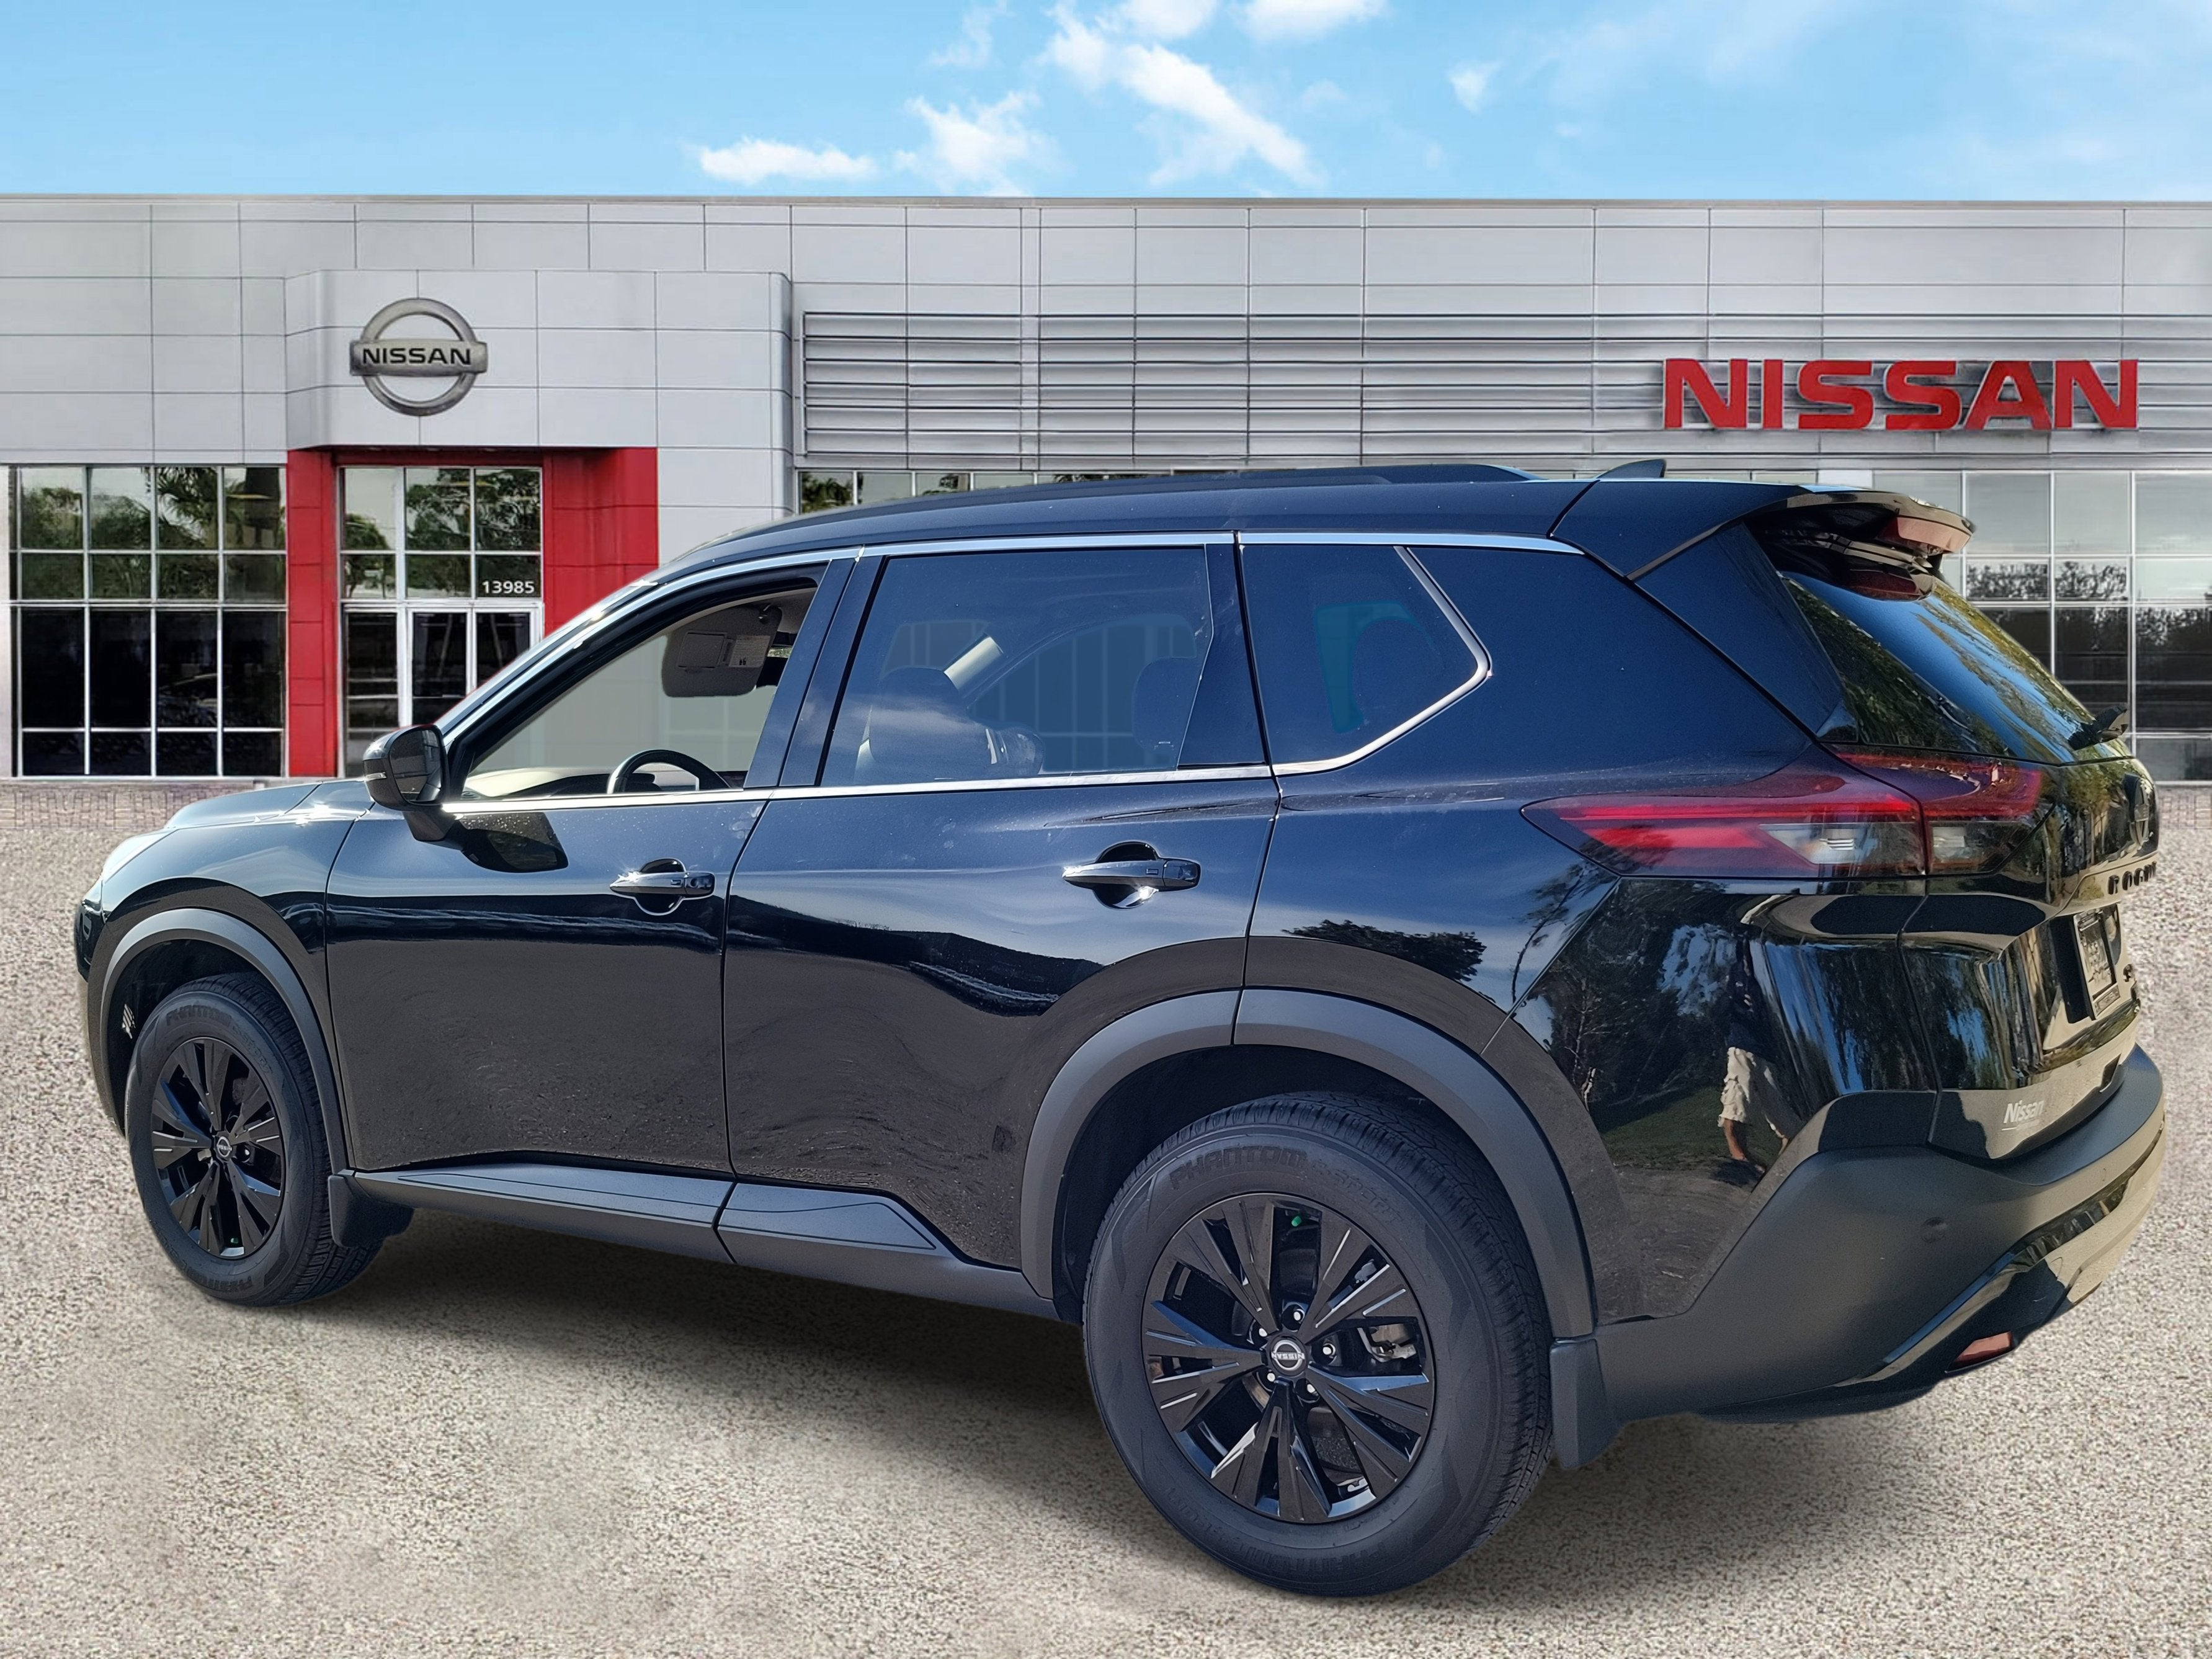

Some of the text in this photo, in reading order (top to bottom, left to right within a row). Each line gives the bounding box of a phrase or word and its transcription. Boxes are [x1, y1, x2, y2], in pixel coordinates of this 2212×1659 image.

[363, 348, 471, 365] NISSAN
[1664, 358, 2138, 430] NISSAN
[482, 580, 535, 594] 13985
[2004, 1100, 2044, 1124] Nissan
[1169, 1145, 1308, 1190] PHANTOM
[1271, 1352, 1305, 1360] NISSAN
